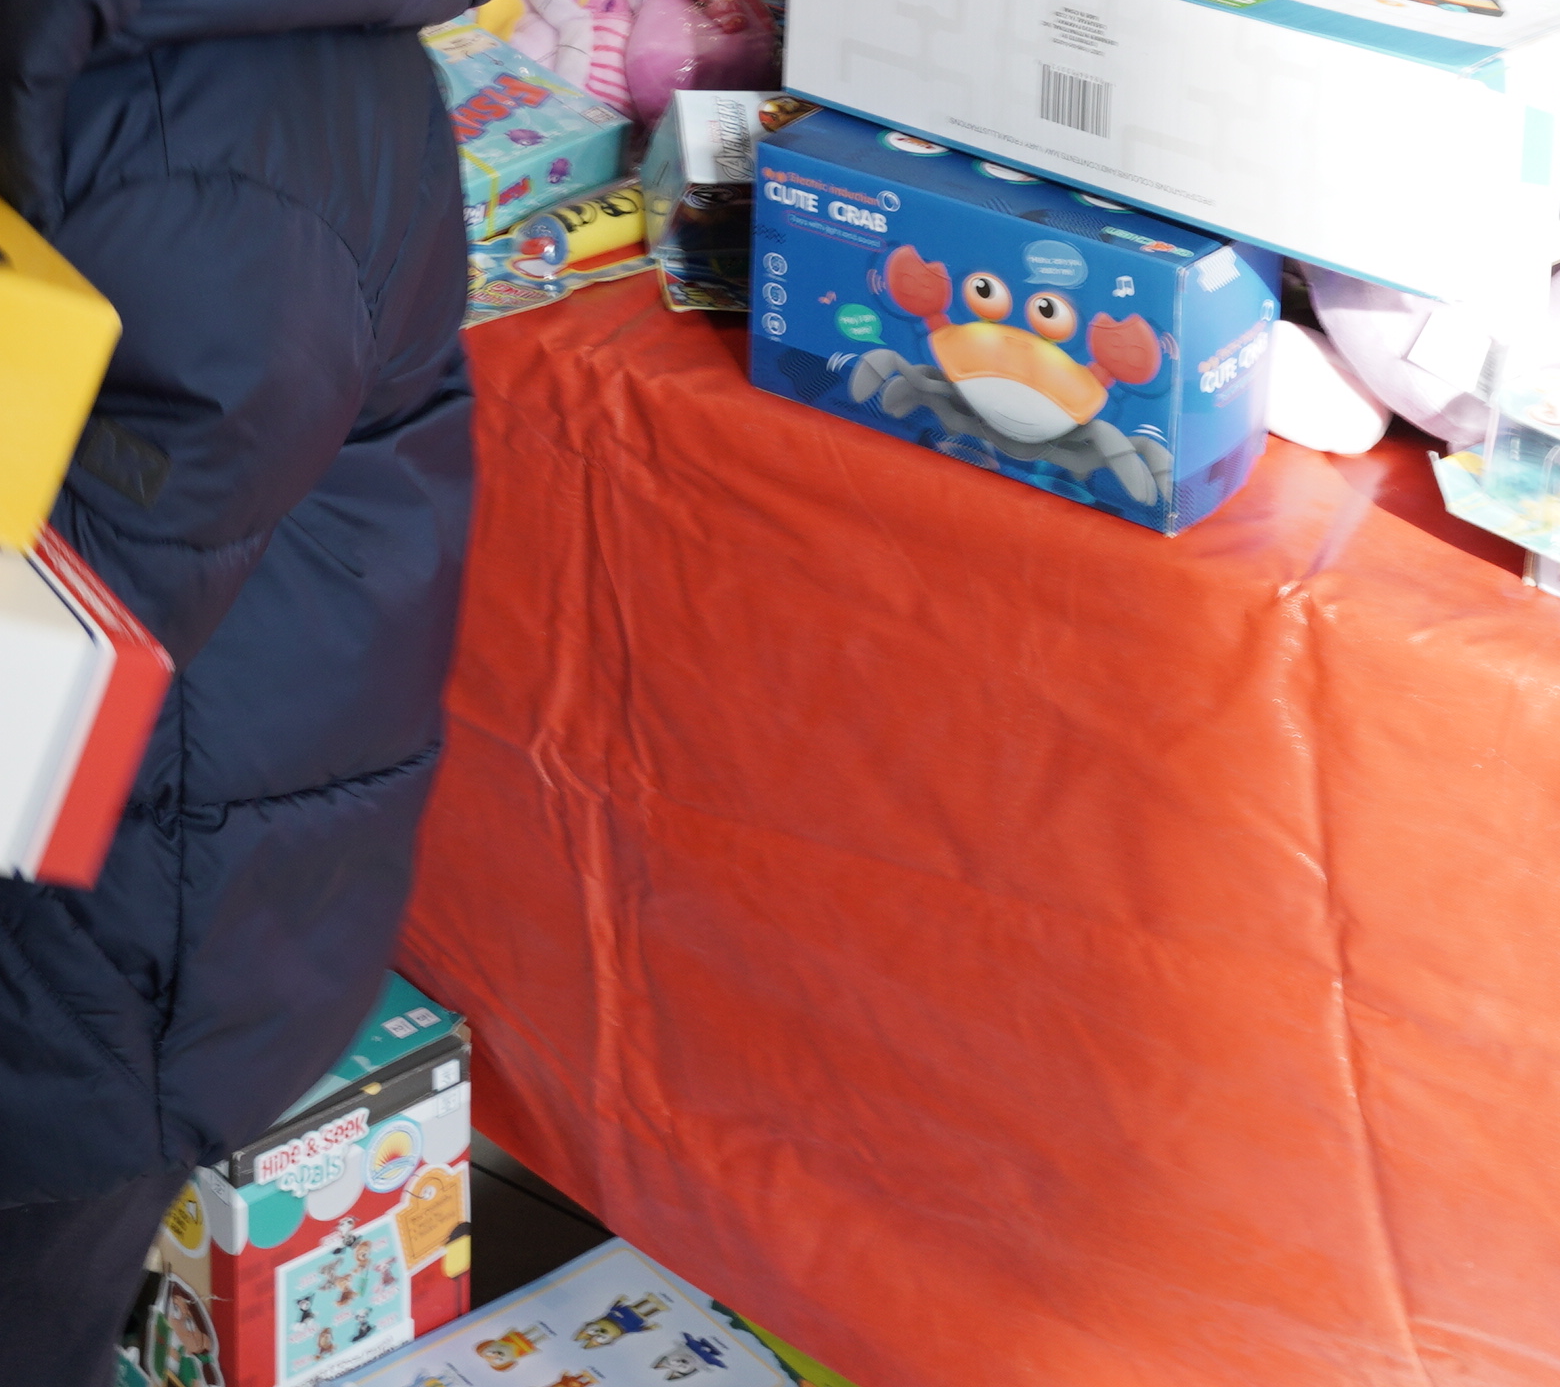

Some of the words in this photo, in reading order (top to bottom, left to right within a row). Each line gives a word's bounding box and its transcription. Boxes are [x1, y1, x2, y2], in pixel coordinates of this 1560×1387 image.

[764, 180, 820, 214] CUTE
[828, 200, 889, 234] CRAB
[305, 1137, 321, 1158] &
